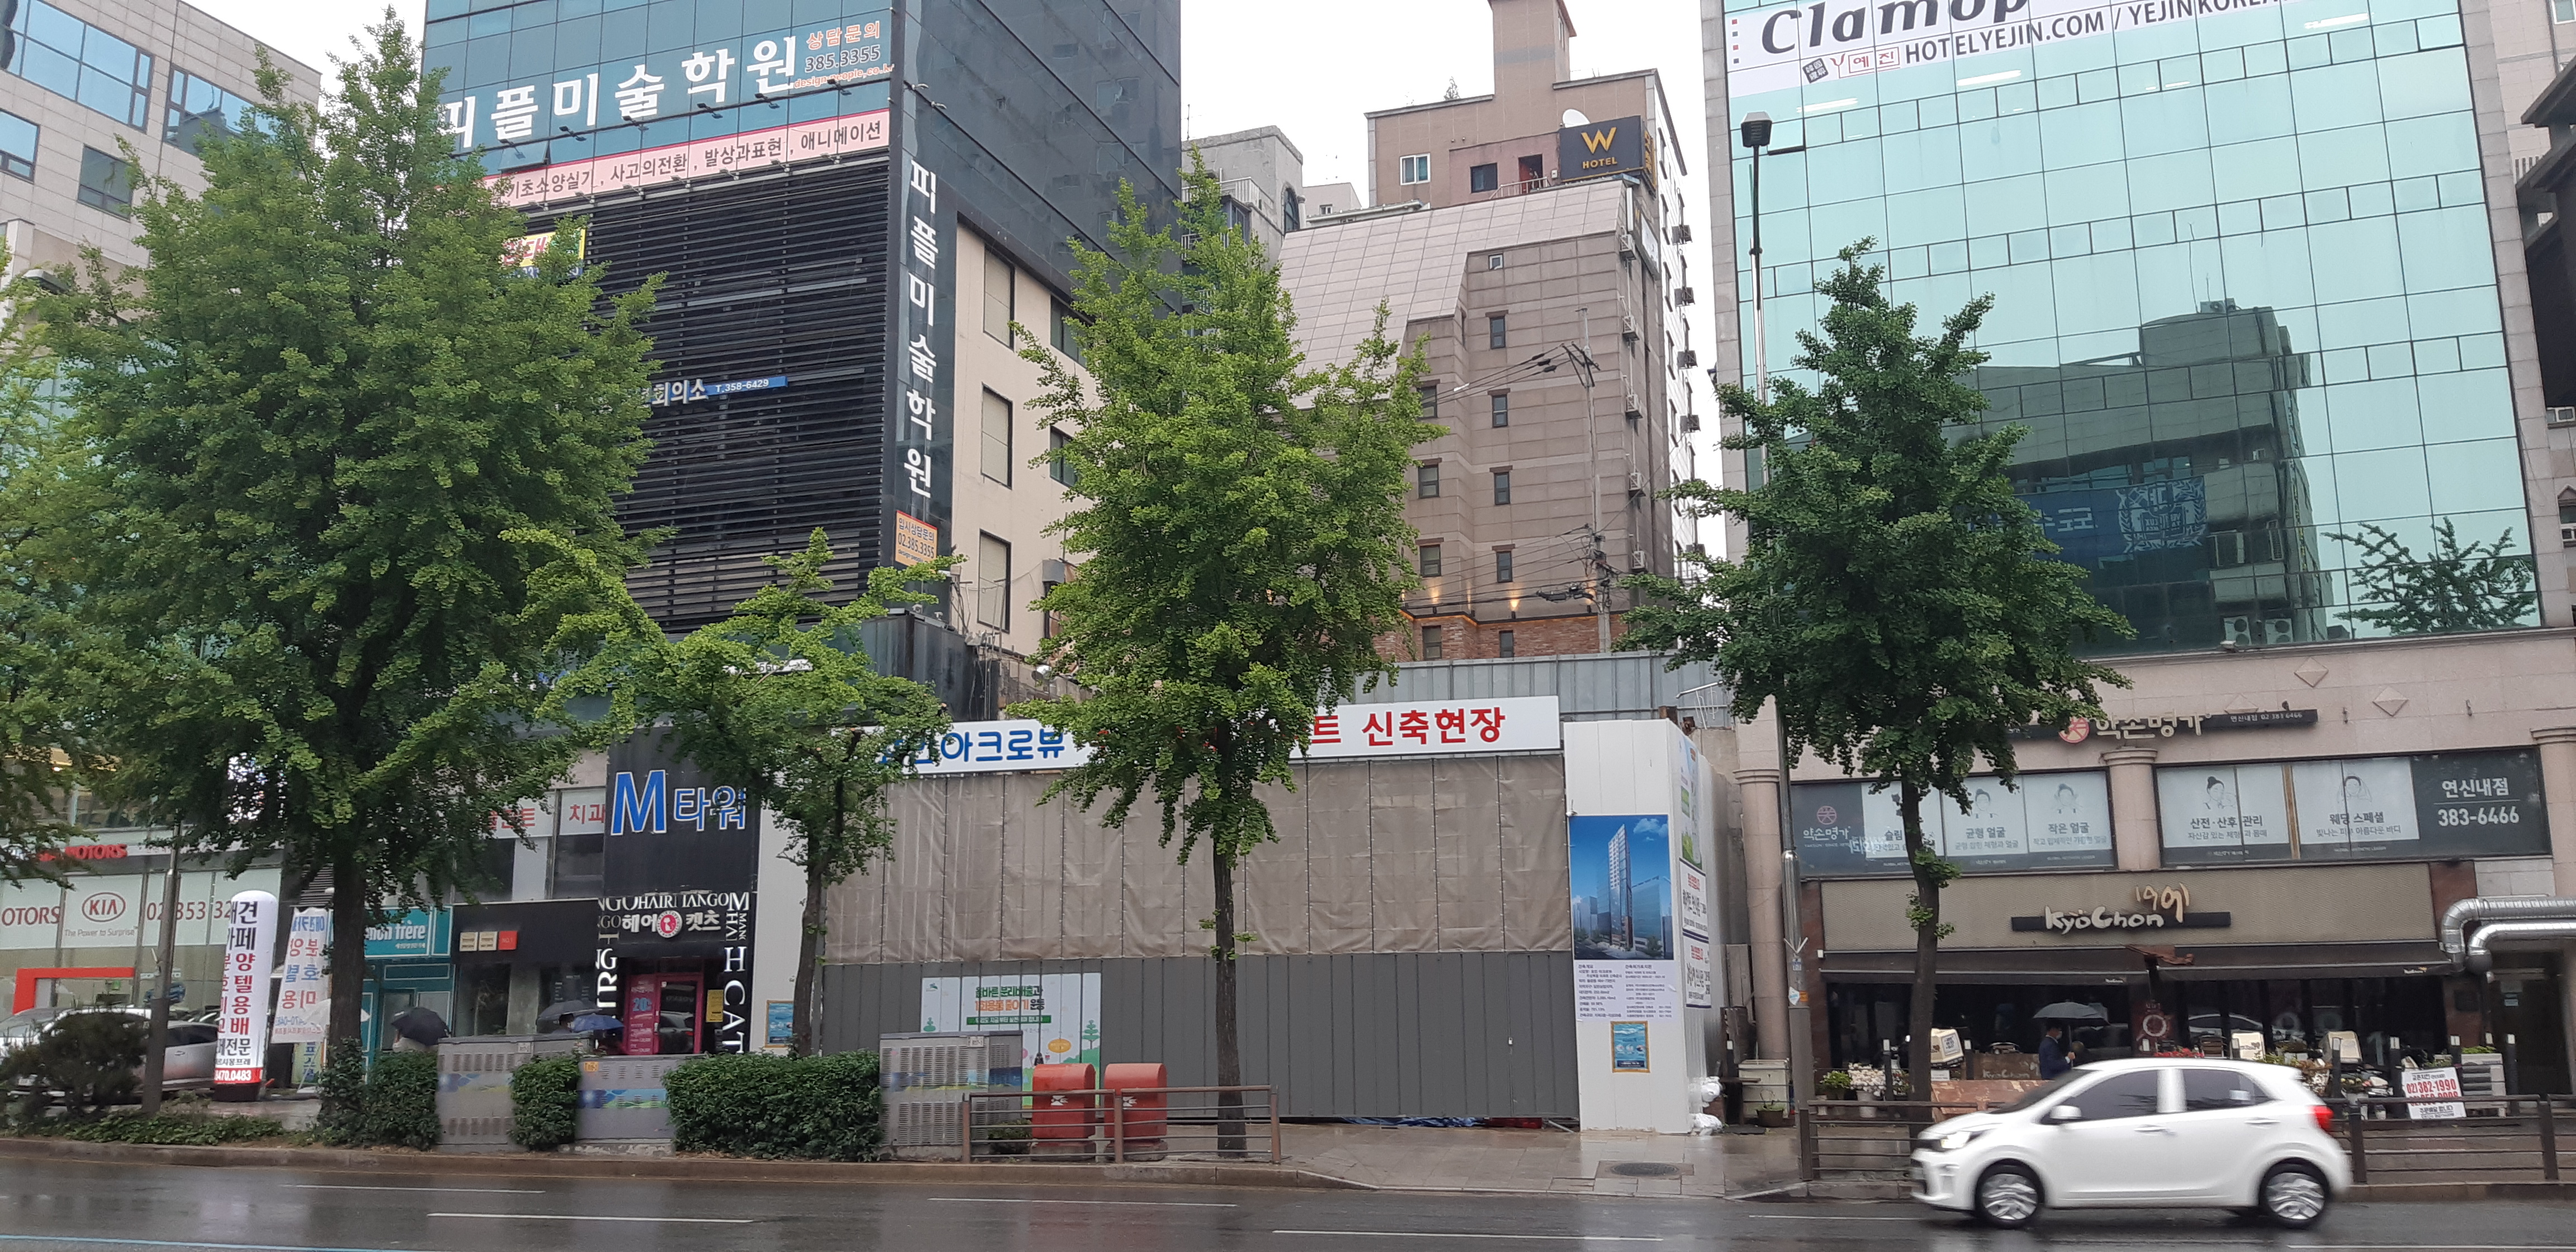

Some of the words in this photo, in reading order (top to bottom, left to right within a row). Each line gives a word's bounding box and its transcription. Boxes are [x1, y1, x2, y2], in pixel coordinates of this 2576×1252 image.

[806, 20, 880, 50] 상담문의
[1906, 11, 2105, 64] HOTELYEJIN.COM
[805, 44, 880, 73] 385.3355
[442, 36, 795, 149] 피플미술학원
[1581, 127, 1617, 154] W
[610, 154, 688, 182] 사고의전환
[704, 141, 782, 166] 발상과표현
[800, 120, 882, 151] 애니메이션
[1583, 156, 1618, 169] HOTEL
[903, 159, 939, 499] 피플미술학원
[716, 379, 769, 393] T.358-6429
[898, 518, 934, 544] 입시상담문의
[898, 532, 935, 559] 02.385.3355
[1361, 706, 1506, 746] 신축현장
[2441, 776, 2509, 799] 연신내점
[569, 804, 605, 824] 치과
[2242, 815, 2263, 827] 관리
[2329, 813, 2350, 825] 웨딩
[2353, 812, 2385, 823] 스페셜
[2437, 807, 2520, 827] 383-6466
[1803, 827, 1849, 841] 약손명가
[1885, 829, 1903, 841] 슬림
[1986, 826, 2006, 838] 얼굴
[2048, 823, 2067, 834] 작은
[2070, 822, 2090, 834] 얼굴
[89, 899, 117, 916] KIA
[622, 914, 659, 932] 헤어
